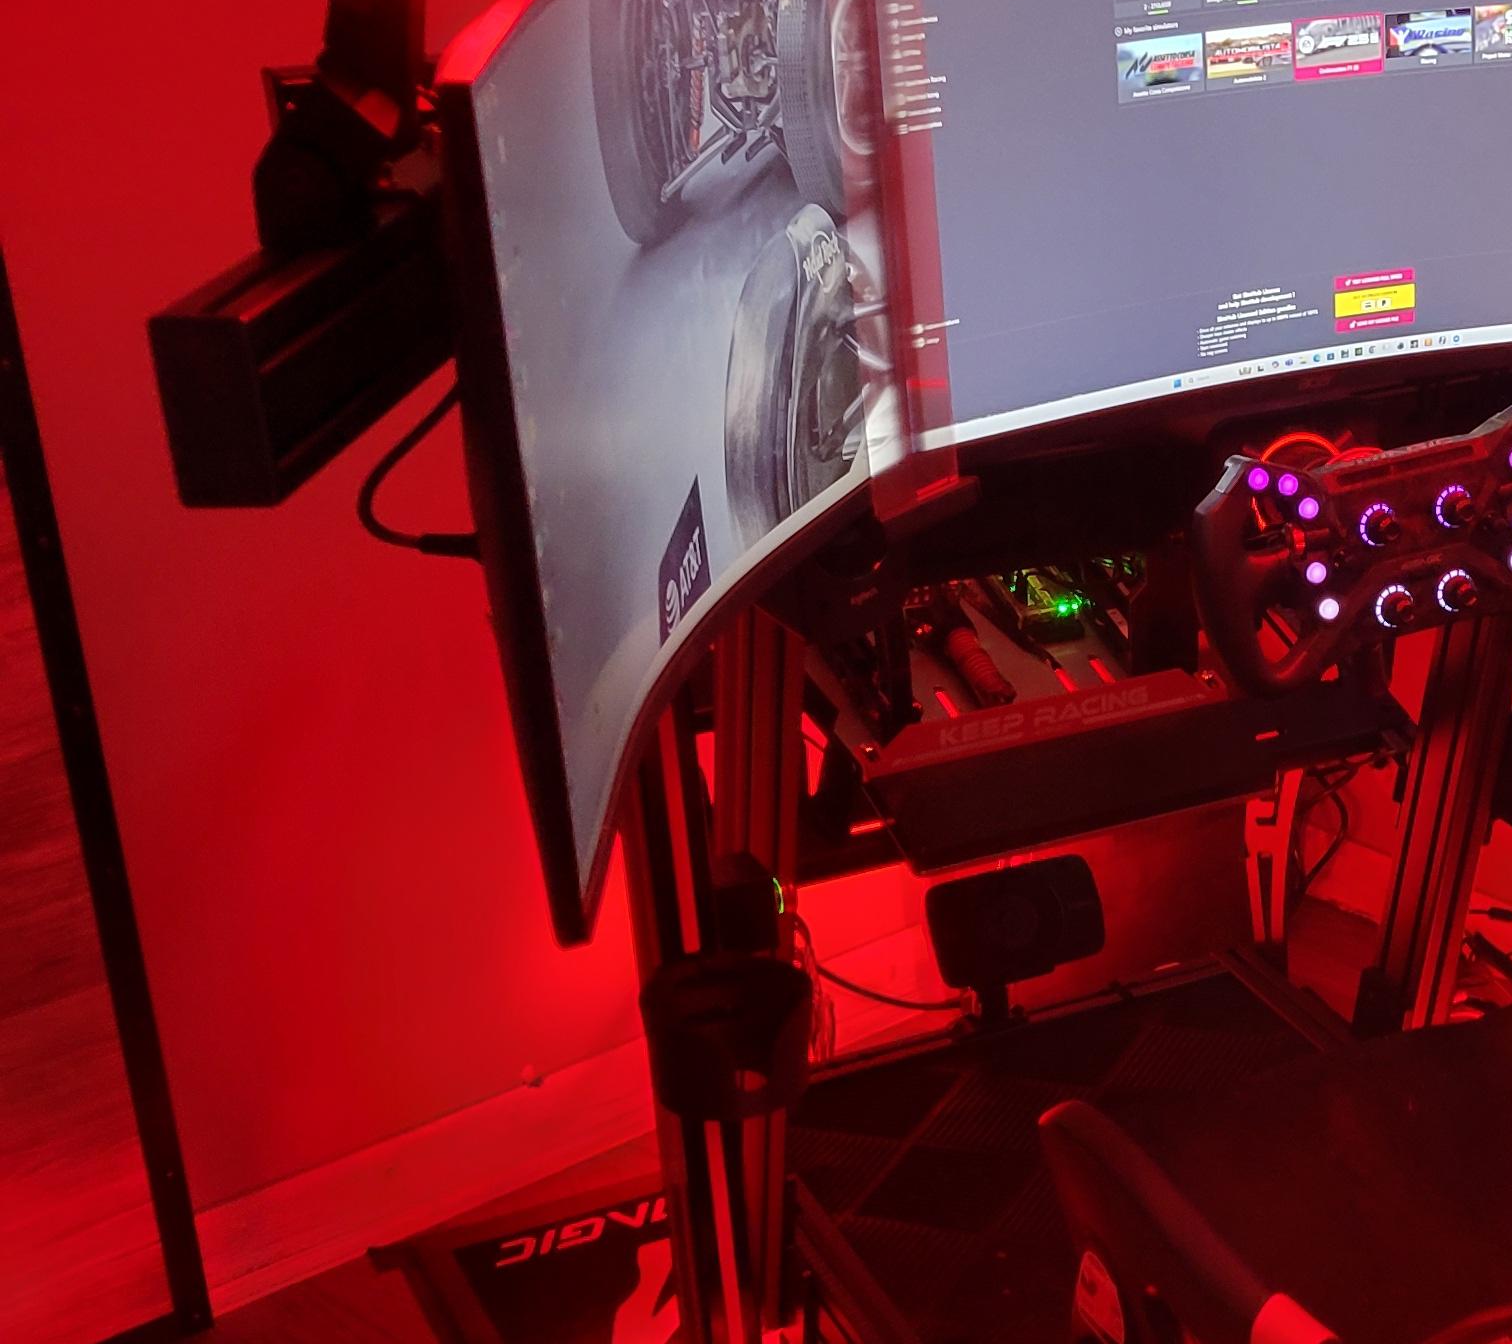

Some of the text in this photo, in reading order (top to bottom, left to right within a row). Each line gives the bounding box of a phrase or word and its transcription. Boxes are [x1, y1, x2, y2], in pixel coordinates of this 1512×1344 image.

[680, 525, 702, 609] AT&T
[939, 685, 1149, 749] KEEP RACING
[496, 1197, 667, 1268] AGIC
